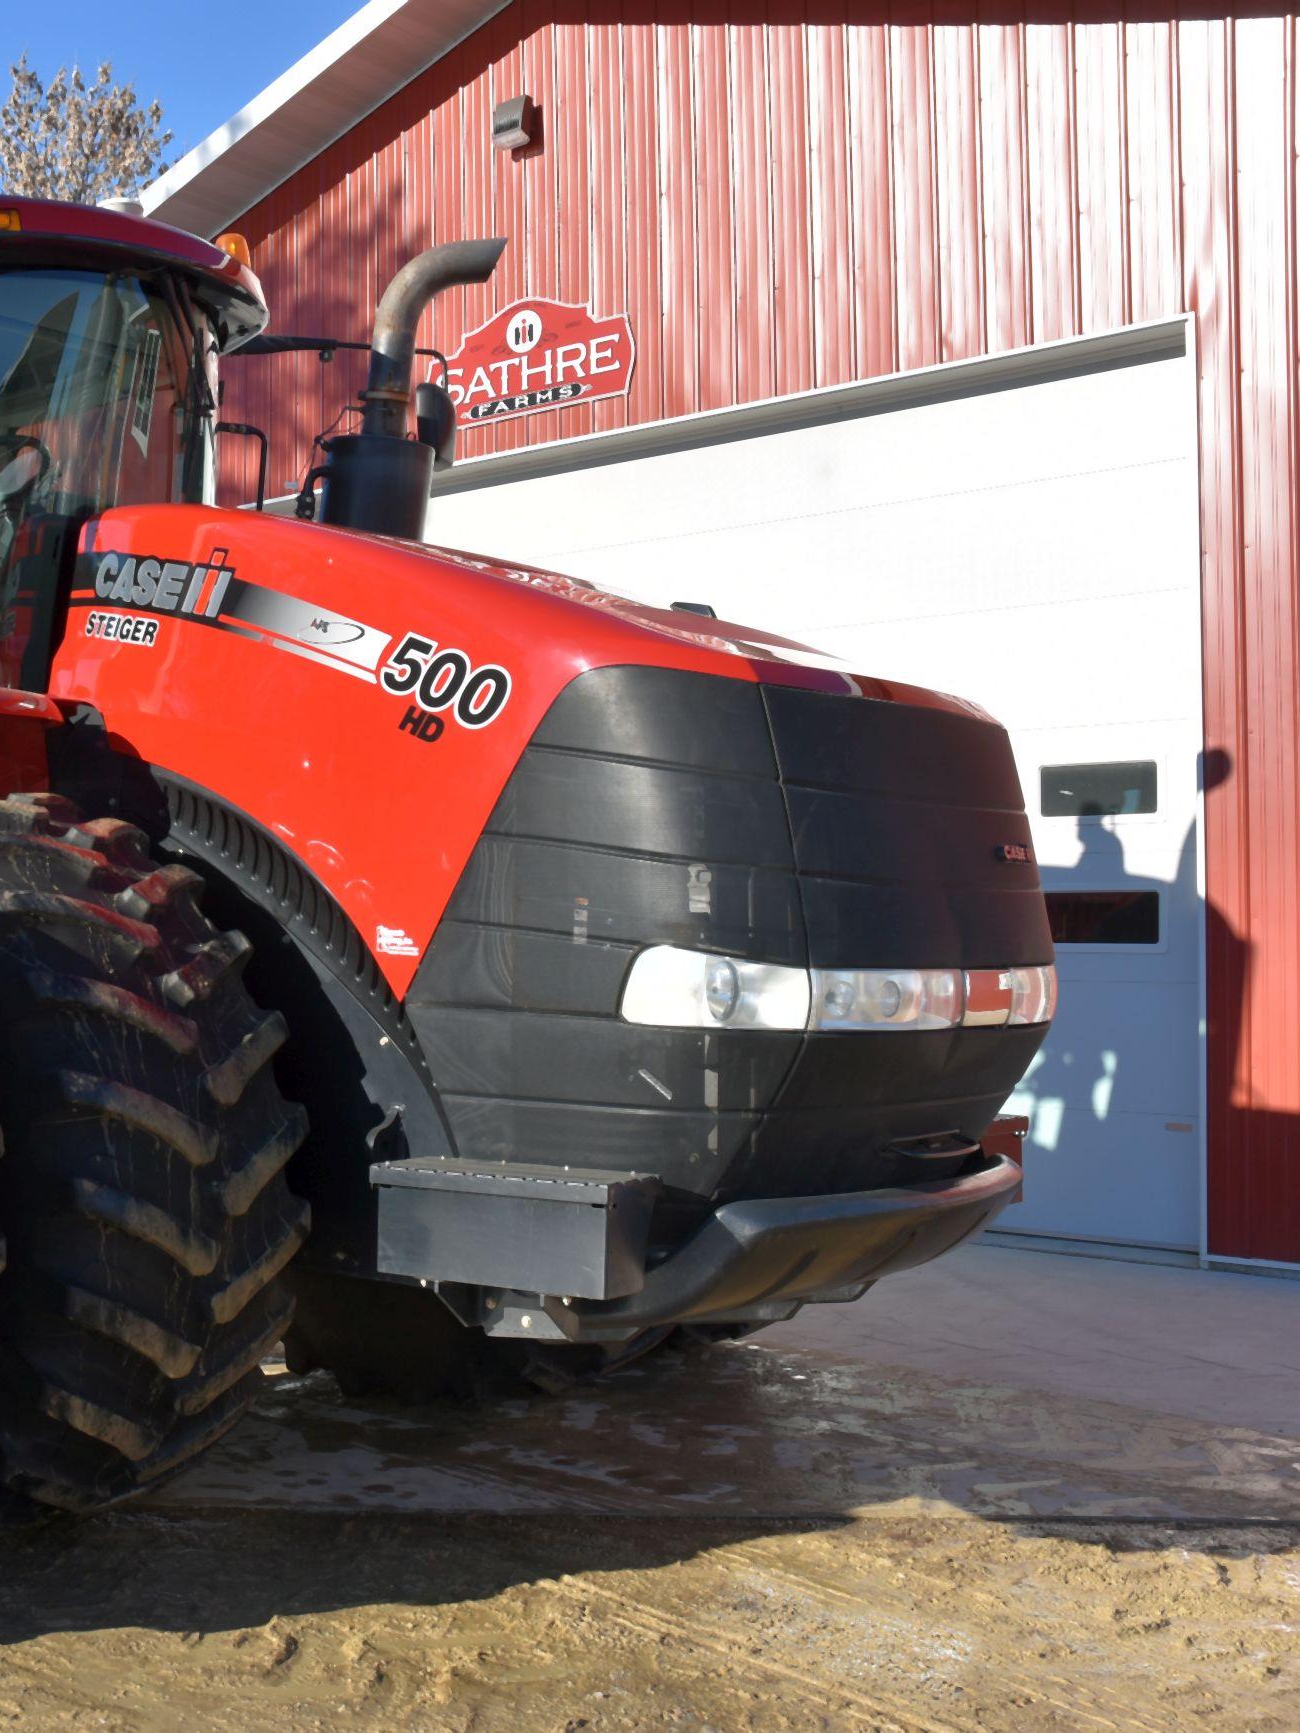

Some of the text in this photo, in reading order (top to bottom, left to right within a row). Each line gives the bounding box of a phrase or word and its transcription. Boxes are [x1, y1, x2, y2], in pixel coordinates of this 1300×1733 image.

[436, 334, 620, 406] SATHRE
[478, 384, 573, 417] FARMS
[85, 611, 158, 646] STEIGER
[381, 633, 511, 728] 500
[398, 706, 445, 743] HD
